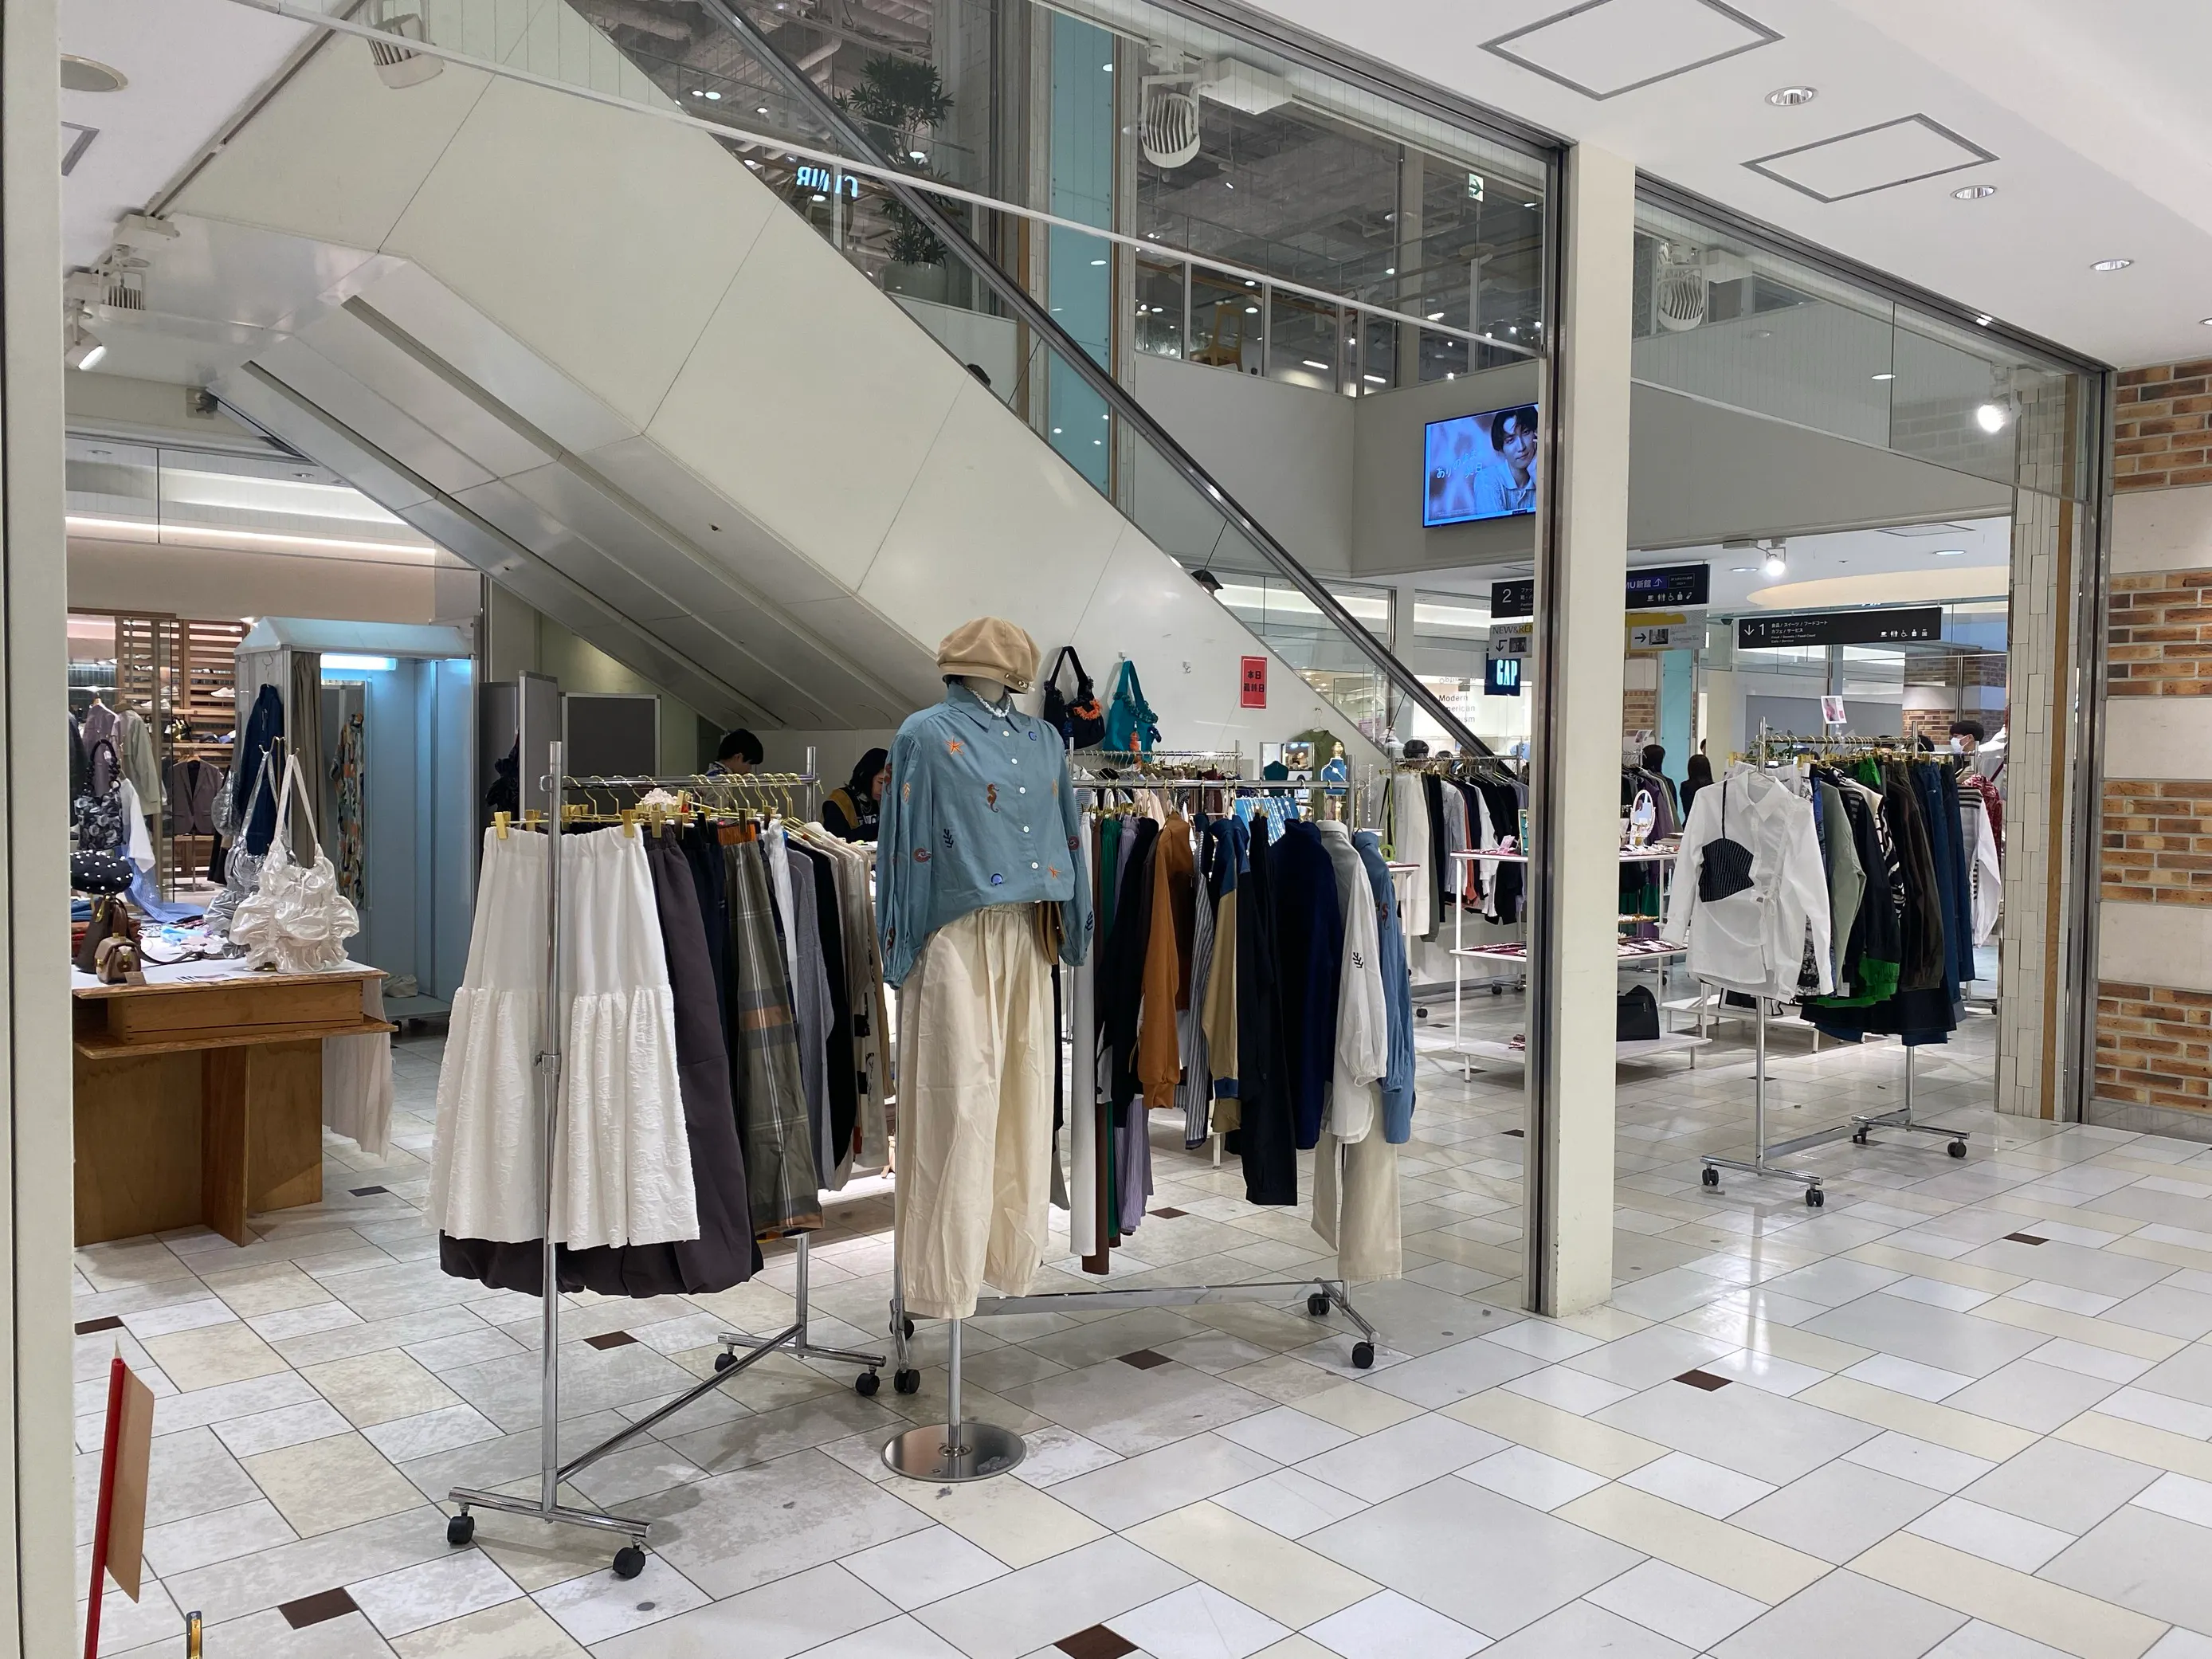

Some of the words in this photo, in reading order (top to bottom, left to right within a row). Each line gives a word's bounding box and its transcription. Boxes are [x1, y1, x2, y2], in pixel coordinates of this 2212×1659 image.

[1502, 588, 1512, 603] 2
[1759, 623, 1765, 636] 1
[1247, 670, 1261, 679] 本日
[1496, 659, 1518, 685] GAP
